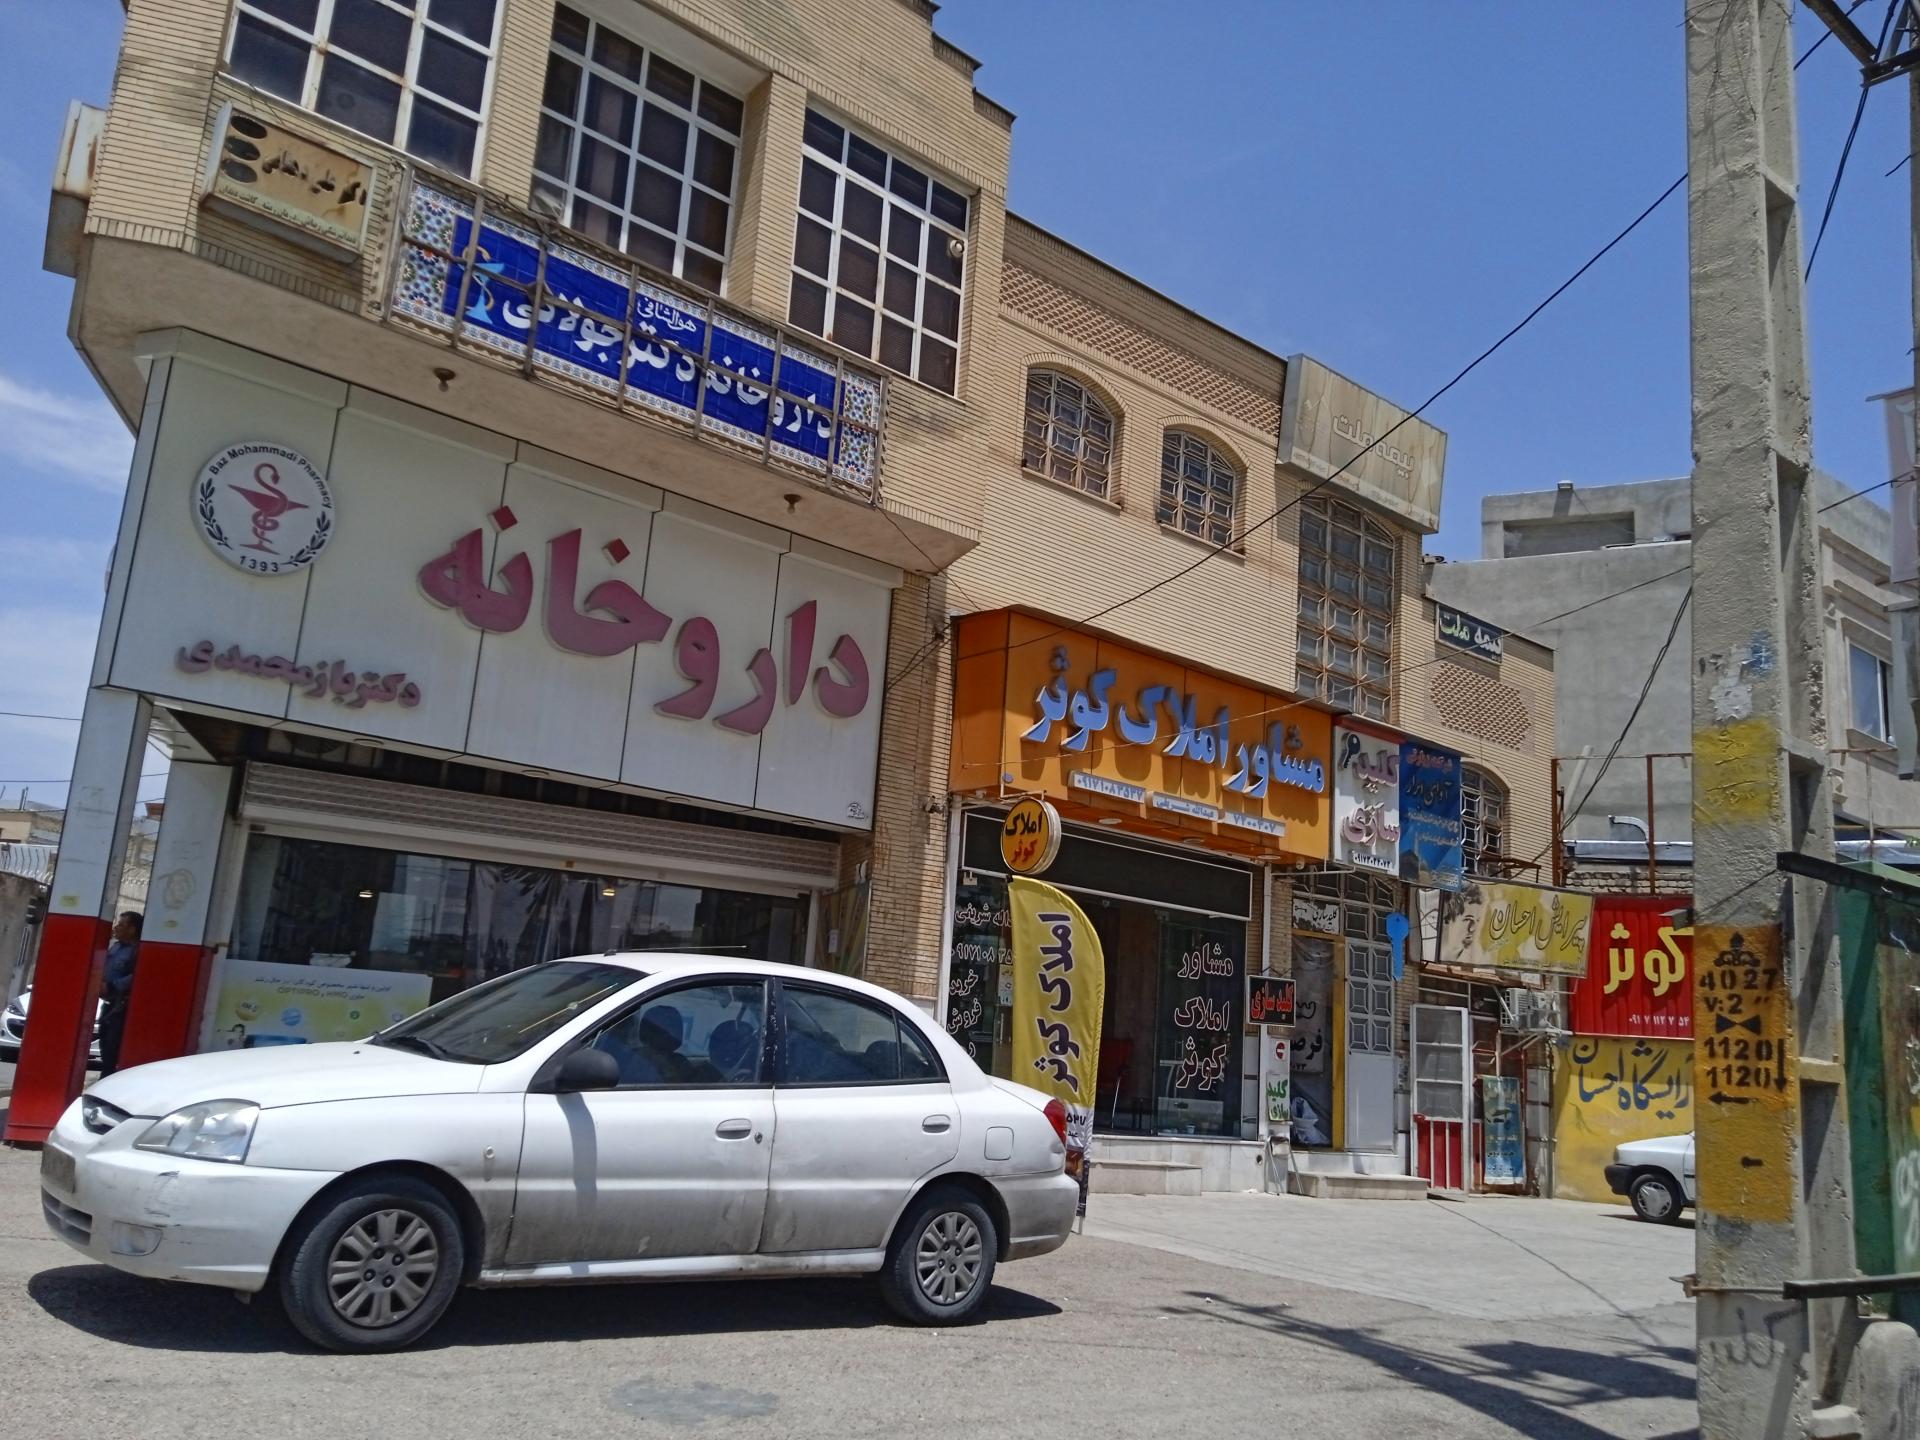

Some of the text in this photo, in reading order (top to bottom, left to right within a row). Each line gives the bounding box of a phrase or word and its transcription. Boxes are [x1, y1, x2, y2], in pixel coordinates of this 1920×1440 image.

[619, 320, 696, 382] دکتر
[705, 355, 835, 439] داروخانه
[209, 445, 332, 509] Baz Mohammadi Pharmacy
[239, 555, 280, 573] 1393
[418, 504, 870, 735] داروخانه
[1020, 643, 1326, 799] مشاور املاک کوثر
[1352, 751, 1400, 794] کلید
[1005, 810, 1043, 836] املاک
[1341, 801, 1401, 847] سازی
[1010, 838, 1038, 864] کوثر
[1037, 912, 1074, 1012] املاک
[1177, 942, 1234, 979] مشاور
[1603, 922, 1694, 996] کوثر
[1700, 968, 1778, 991] 4027
[950, 968, 979, 996] خرید
[1250, 980, 1296, 1020] کلید سازی
[946, 997, 982, 1035] فروش
[1174, 996, 1230, 1032] املاک
[1033, 1017, 1080, 1093] کوثر
[1175, 1035, 1227, 1091] کوثر
[1289, 1027, 1323, 1060] فرص
[1704, 1036, 1773, 1061] 1120
[1618, 1039, 1694, 1120] رایشگاه
[1706, 1063, 1771, 1088] 1120
